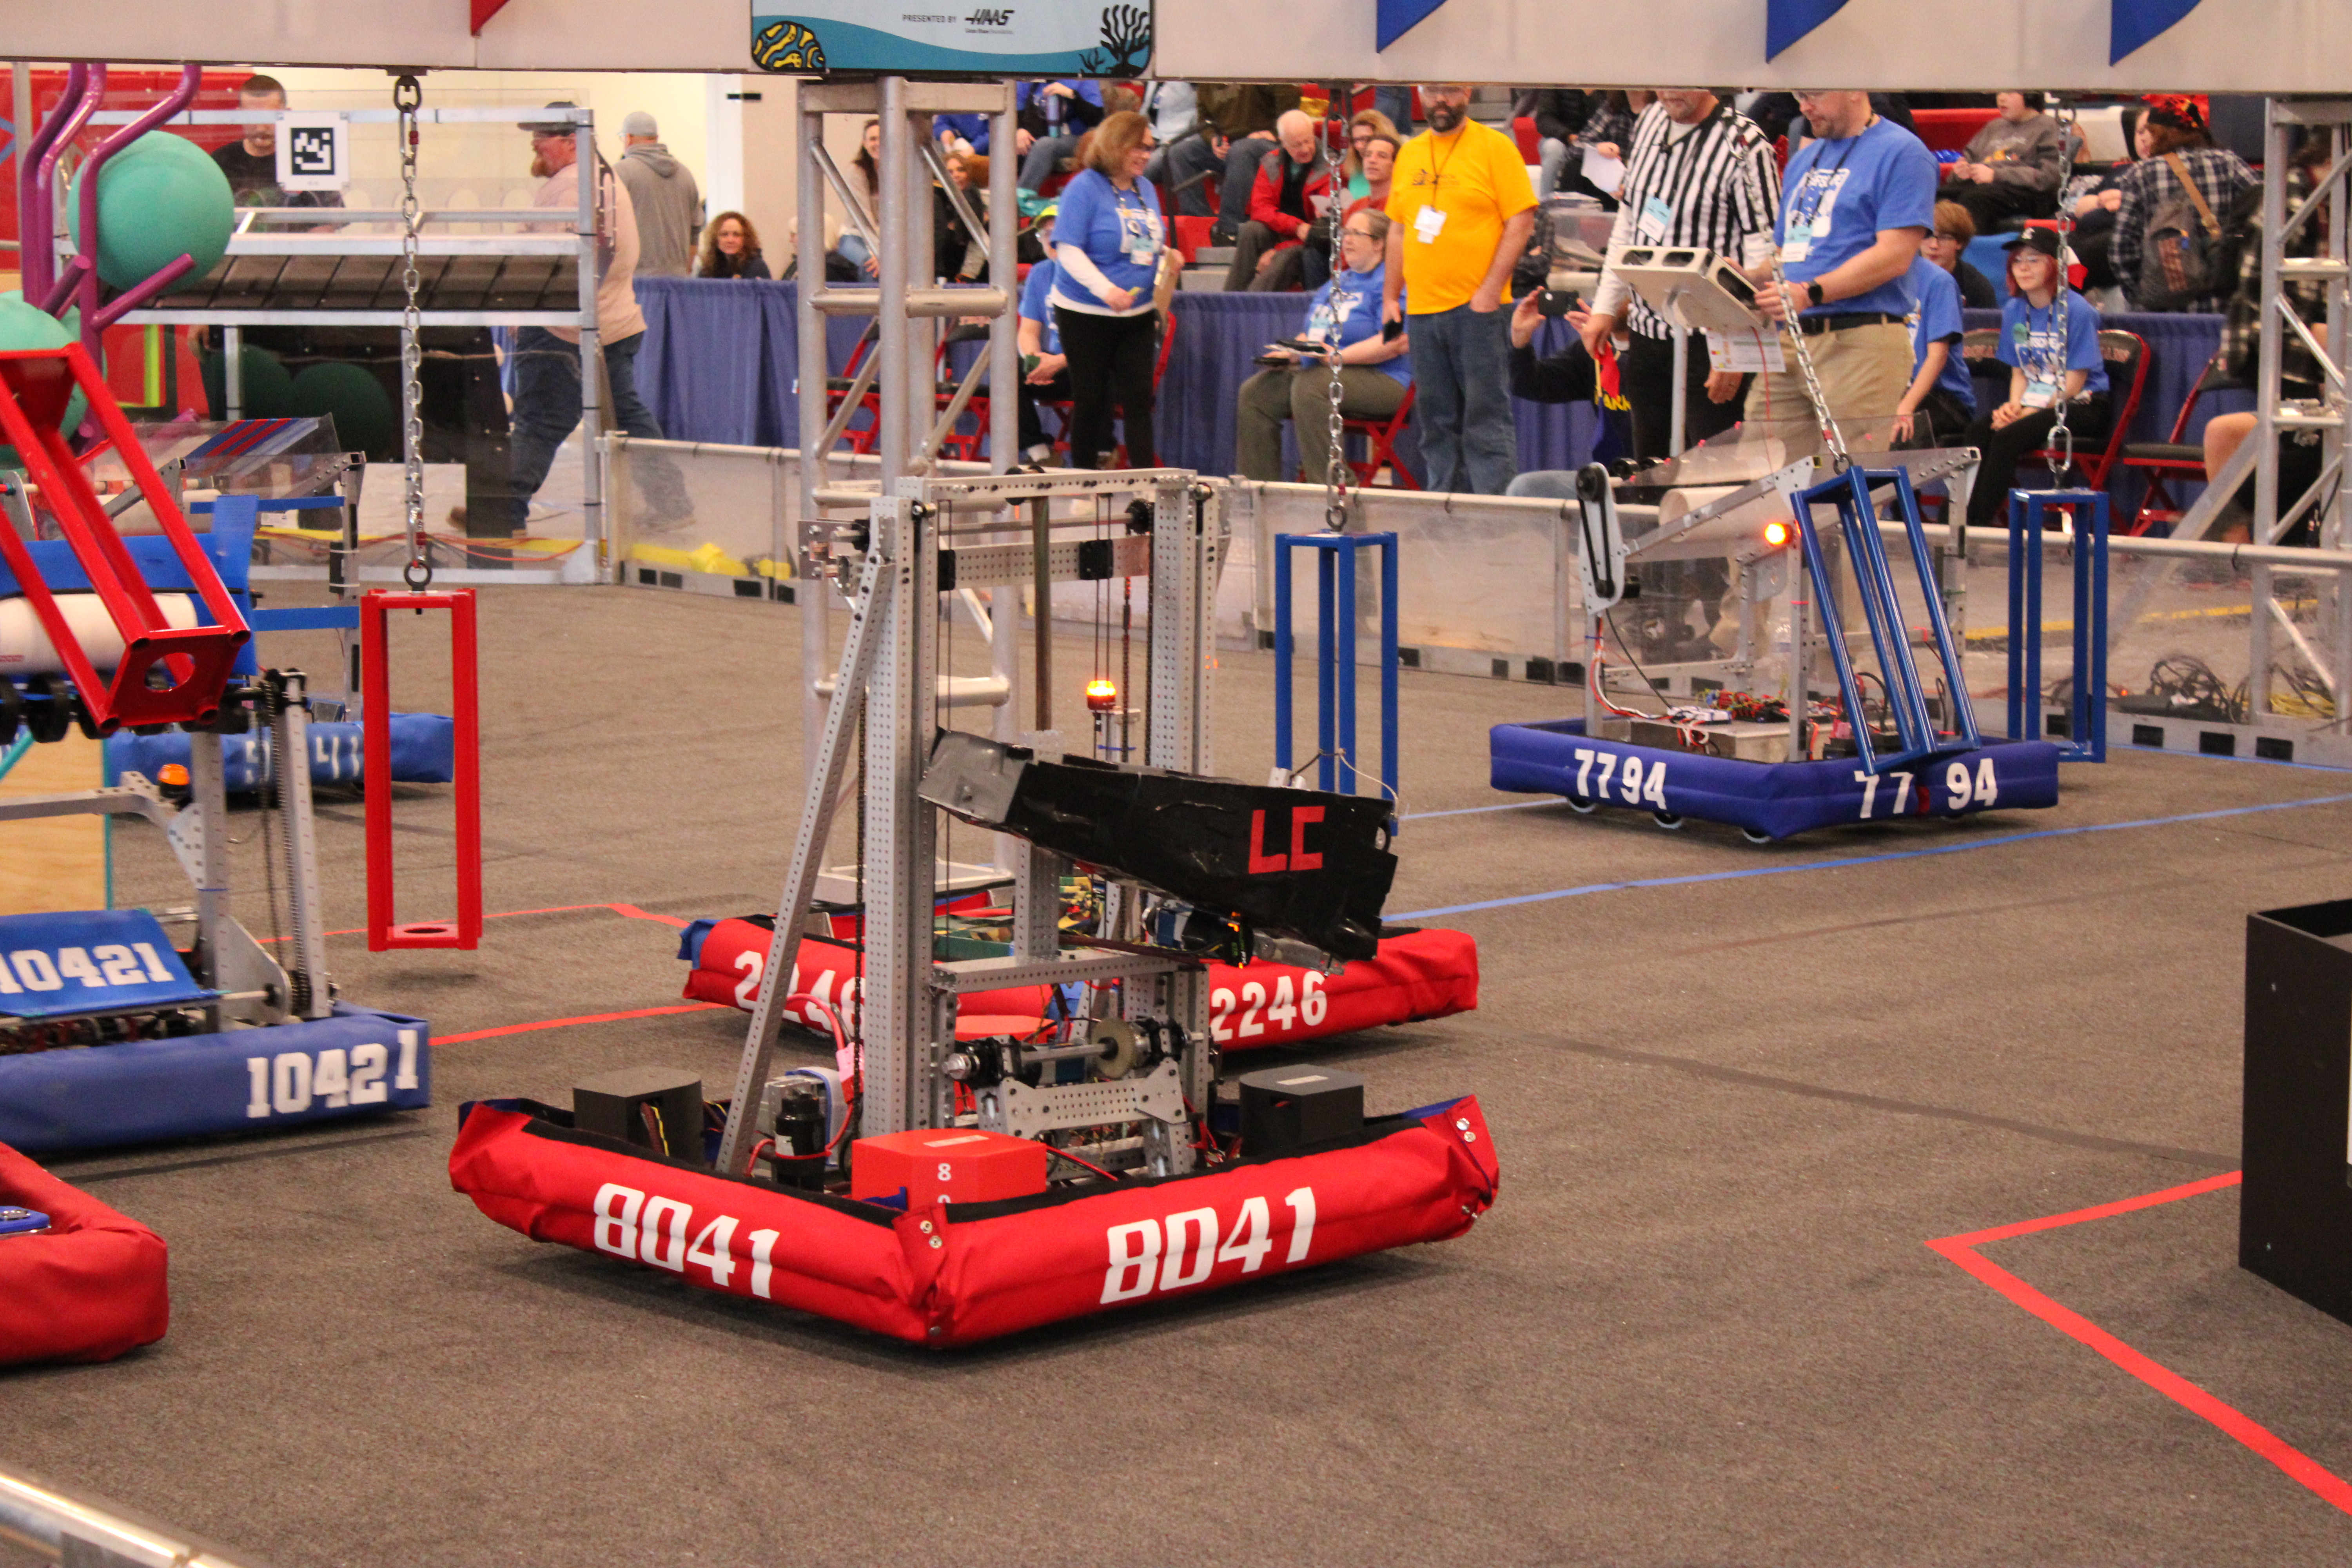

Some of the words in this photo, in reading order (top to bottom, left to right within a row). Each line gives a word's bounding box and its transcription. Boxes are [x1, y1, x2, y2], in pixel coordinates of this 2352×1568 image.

[964, 9, 1014, 25] HAAS
[1574, 748, 1667, 810] 7794
[1248, 806, 1325, 874] LC
[1210, 971, 1327, 1042] 2246
[247, 1029, 419, 1118] 10421
[593, 1183, 780, 1299] 8041
[1100, 1186, 1316, 1305] 8041
